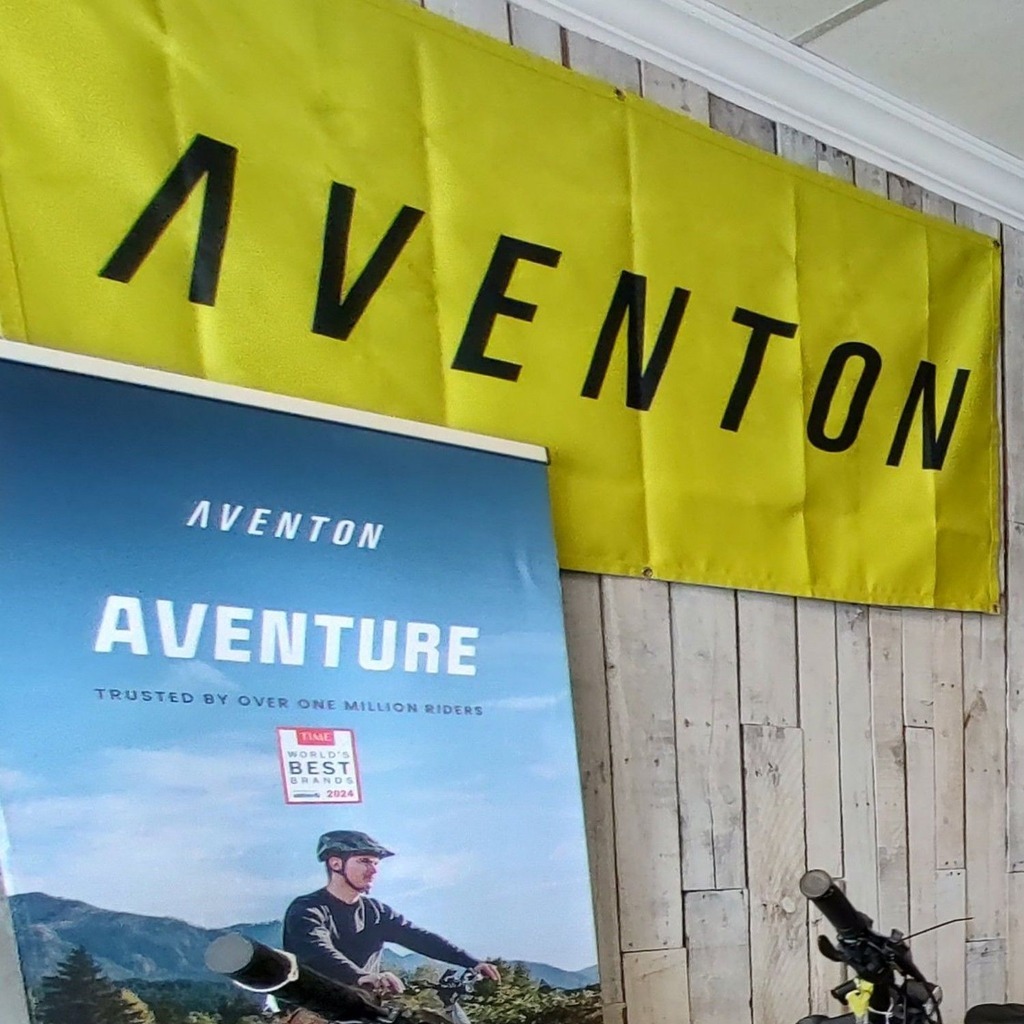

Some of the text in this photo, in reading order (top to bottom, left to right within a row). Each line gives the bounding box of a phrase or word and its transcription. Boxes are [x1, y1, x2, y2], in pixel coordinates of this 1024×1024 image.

[100, 133, 971, 471] AVENTON
[186, 500, 385, 550] AVENTON
[94, 595, 480, 677] AVENTURE
[94, 688, 484, 716] TRUSTED BY OVER ONE MILLION RIDERS
[300, 731, 332, 742] TIME
[287, 751, 350, 759] WORLD'S
[288, 761, 350, 775] BEST
[290, 777, 354, 785] BRANDS
[326, 789, 354, 798] 2024
